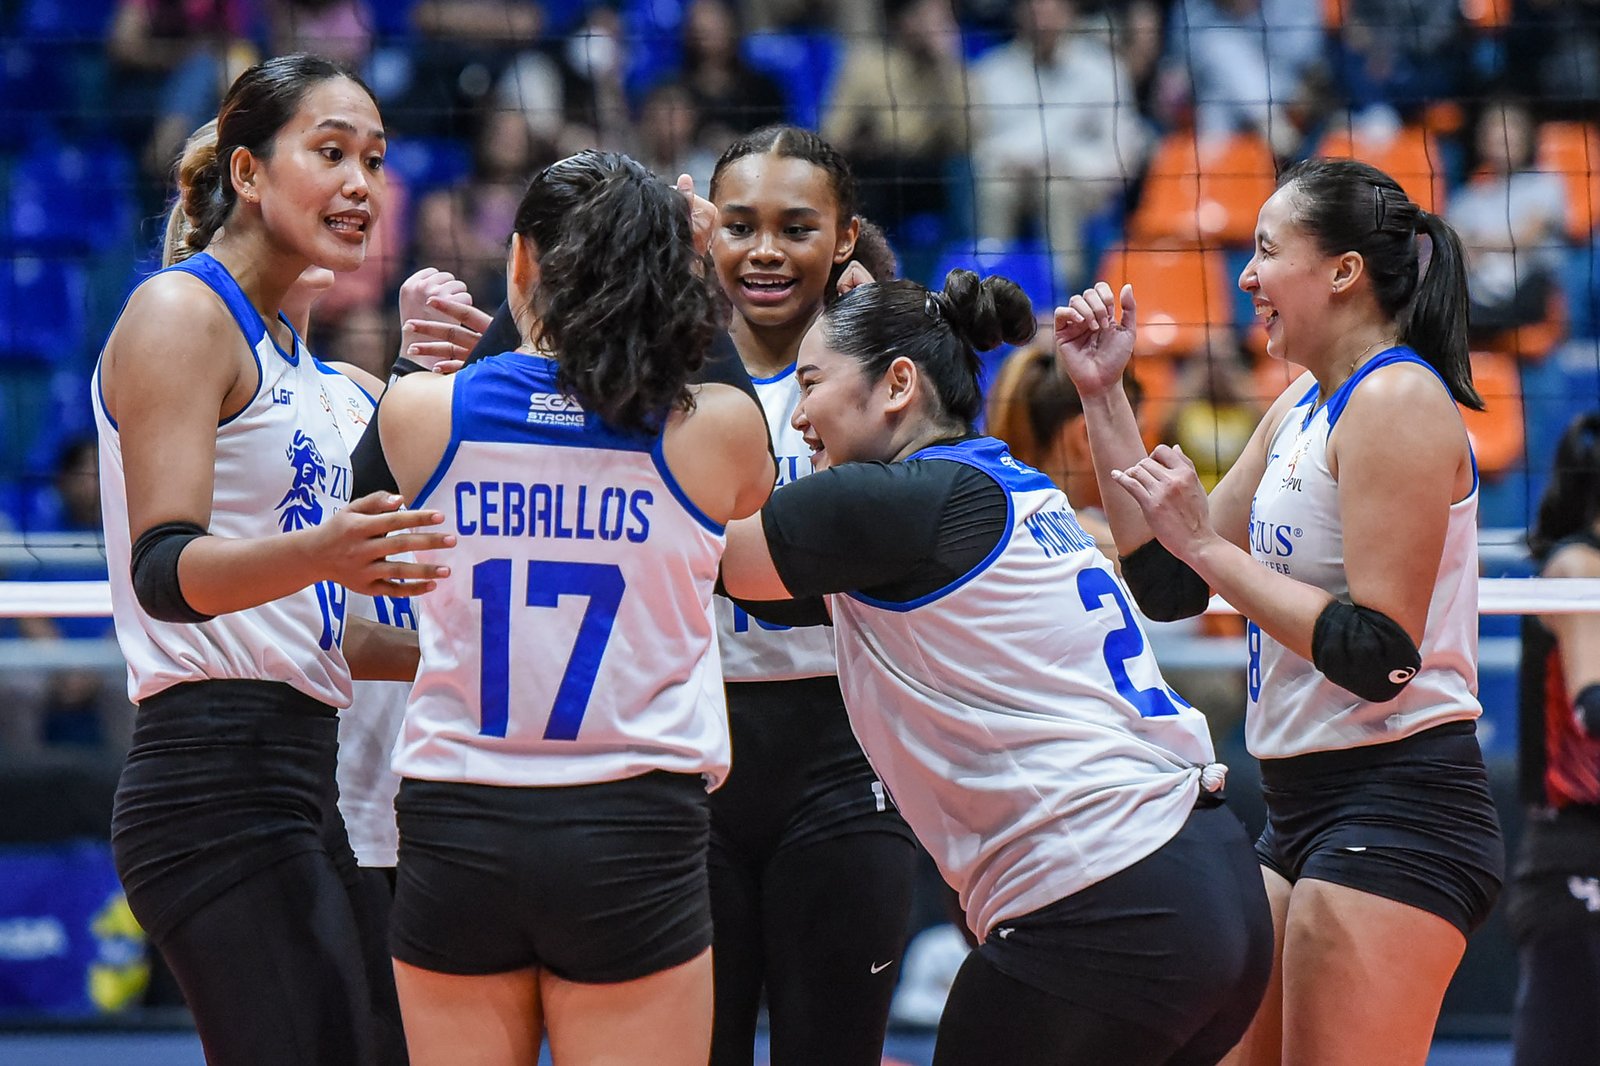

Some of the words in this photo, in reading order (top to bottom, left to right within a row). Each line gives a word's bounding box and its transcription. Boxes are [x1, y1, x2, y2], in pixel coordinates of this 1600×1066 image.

[527, 411, 585, 423] STRONG
[529, 392, 584, 413] SGA
[455, 481, 653, 543] CEBALLOS
[314, 580, 346, 652] 19
[472, 558, 626, 741] 17
